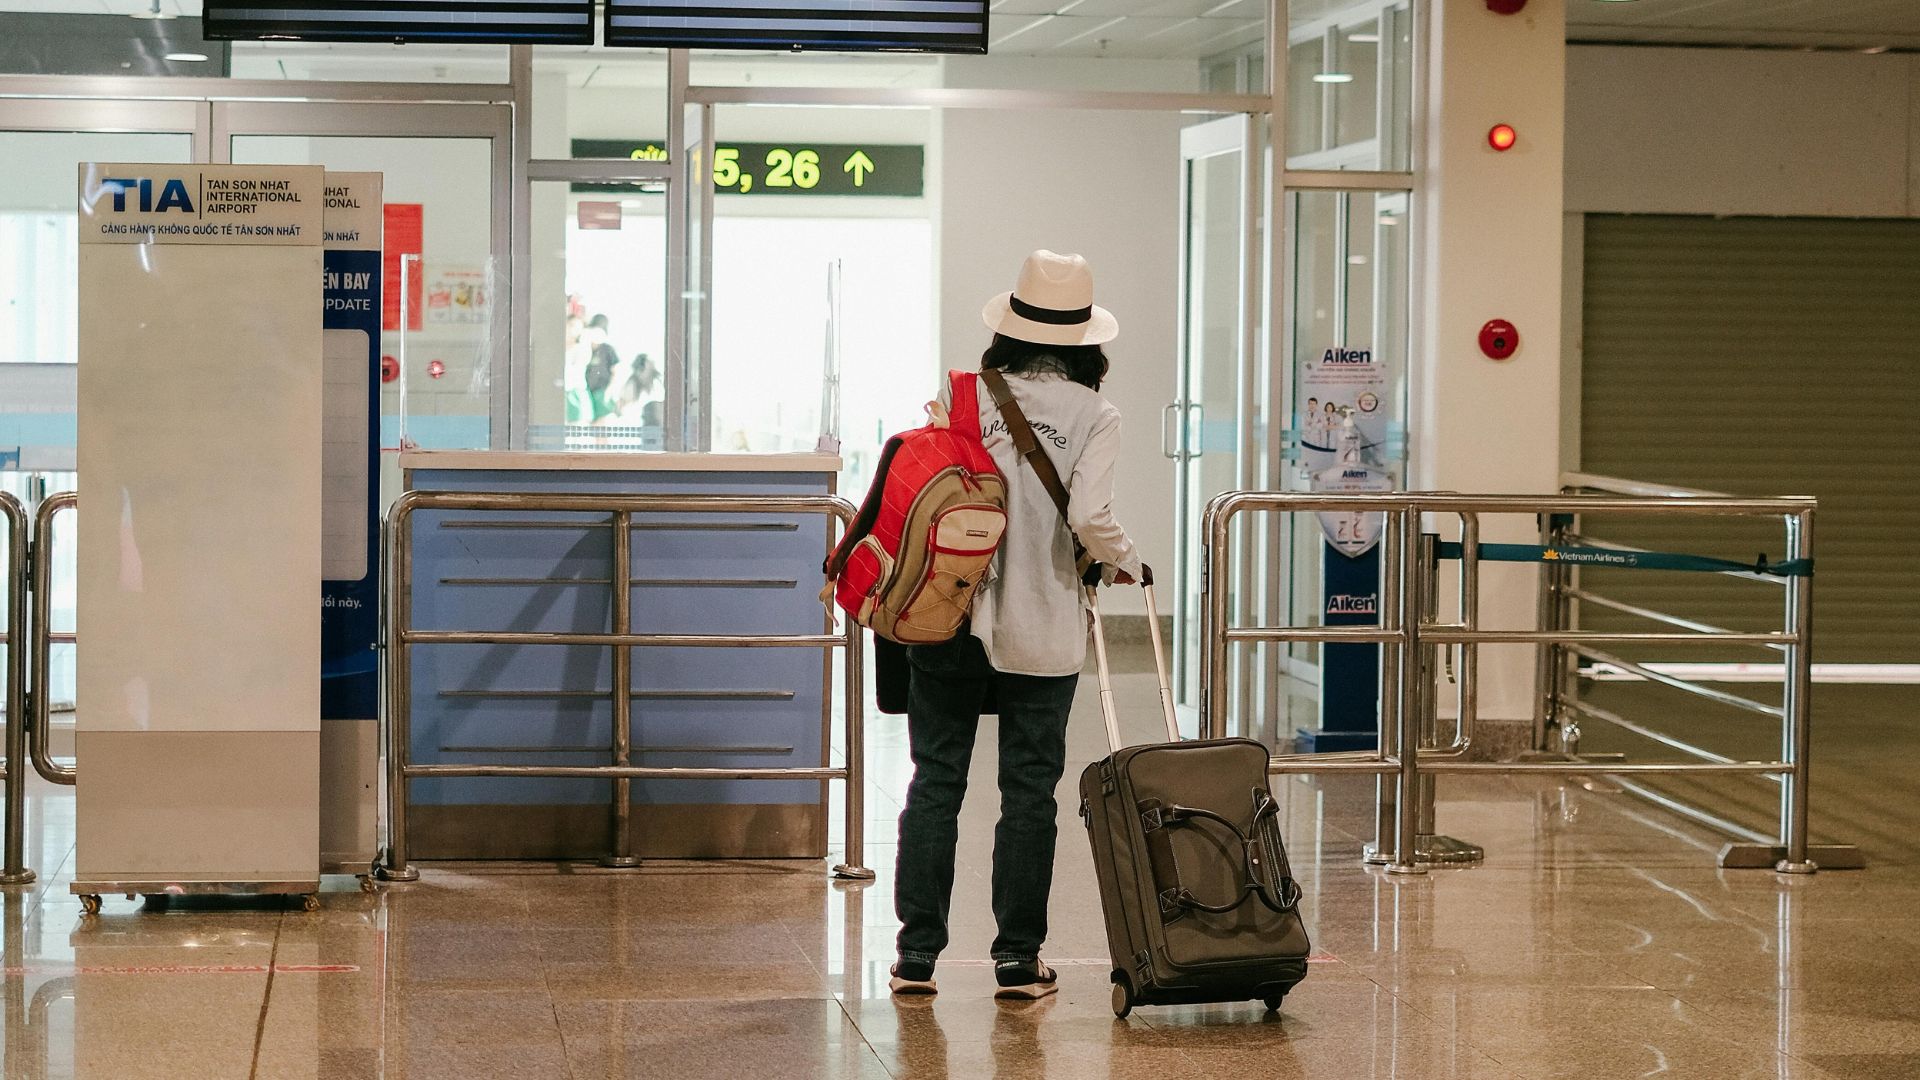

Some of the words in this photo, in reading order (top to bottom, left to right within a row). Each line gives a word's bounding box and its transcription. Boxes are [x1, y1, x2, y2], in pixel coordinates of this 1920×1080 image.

[766, 149, 820, 189] 26
[207, 180, 229, 190] TAN
[232, 180, 256, 190] SON
[260, 181, 290, 190] NHAT
[102, 178, 195, 212] TIA
[206, 192, 301, 202] INTERNATIONAL
[207, 204, 257, 213] AIRPORT
[158, 224, 190, 235] KHÔNG
[192, 223, 218, 236] QUỐC
[235, 224, 253, 236] TÂN
[344, 272, 371, 290] BAY
[326, 298, 371, 311] PDATE
[1323, 348, 1371, 363] Aiken
[1342, 470, 1367, 479] Aiken
[1559, 551, 1594, 561] Vietnam
[1594, 553, 1625, 563] Airlines
[338, 597, 362, 609] này.
[1327, 595, 1377, 612] Aiken
